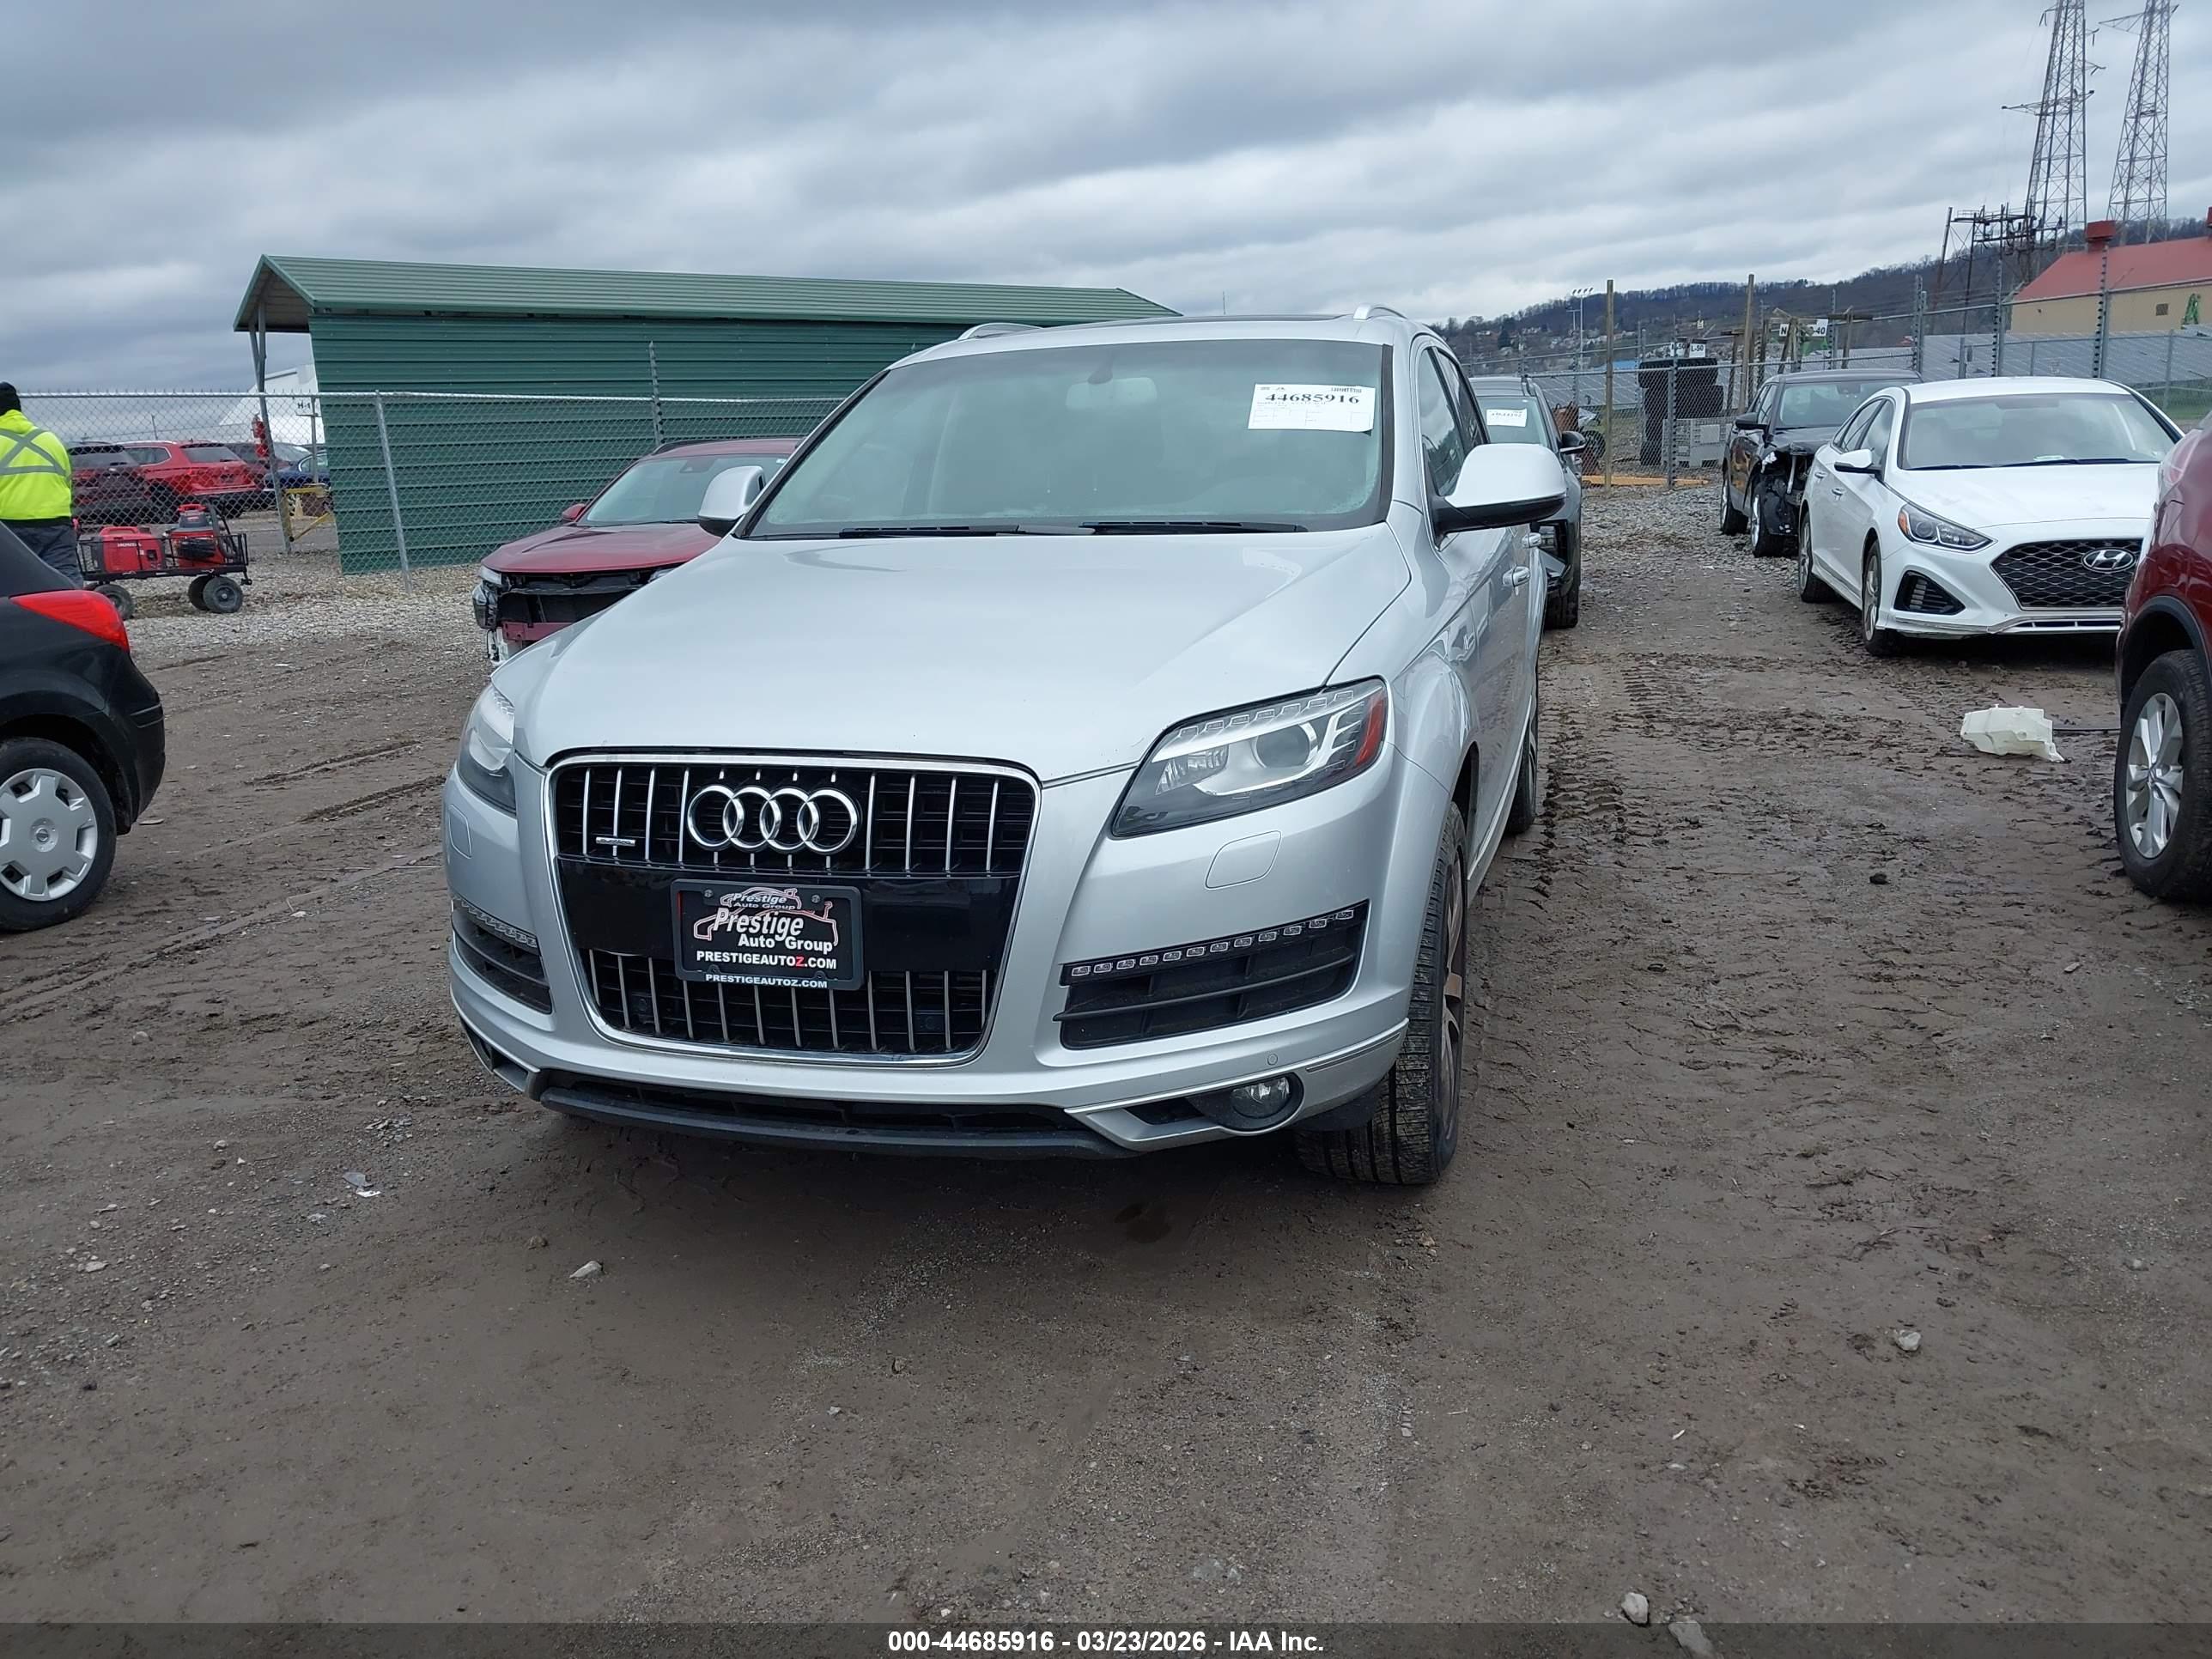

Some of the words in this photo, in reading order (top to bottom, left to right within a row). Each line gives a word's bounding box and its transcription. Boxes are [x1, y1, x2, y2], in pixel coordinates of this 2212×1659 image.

[1265, 393, 1360, 404] 44685916
[732, 893, 787, 904] Prestige
[713, 908, 805, 942] Prestige
[738, 934, 775, 949] Auto
[785, 936, 834, 955] Group
[696, 951, 837, 969] PRESTIGEAUTOZ.COM
[705, 975, 828, 988] PRESTIGEAUTOZ.COM
